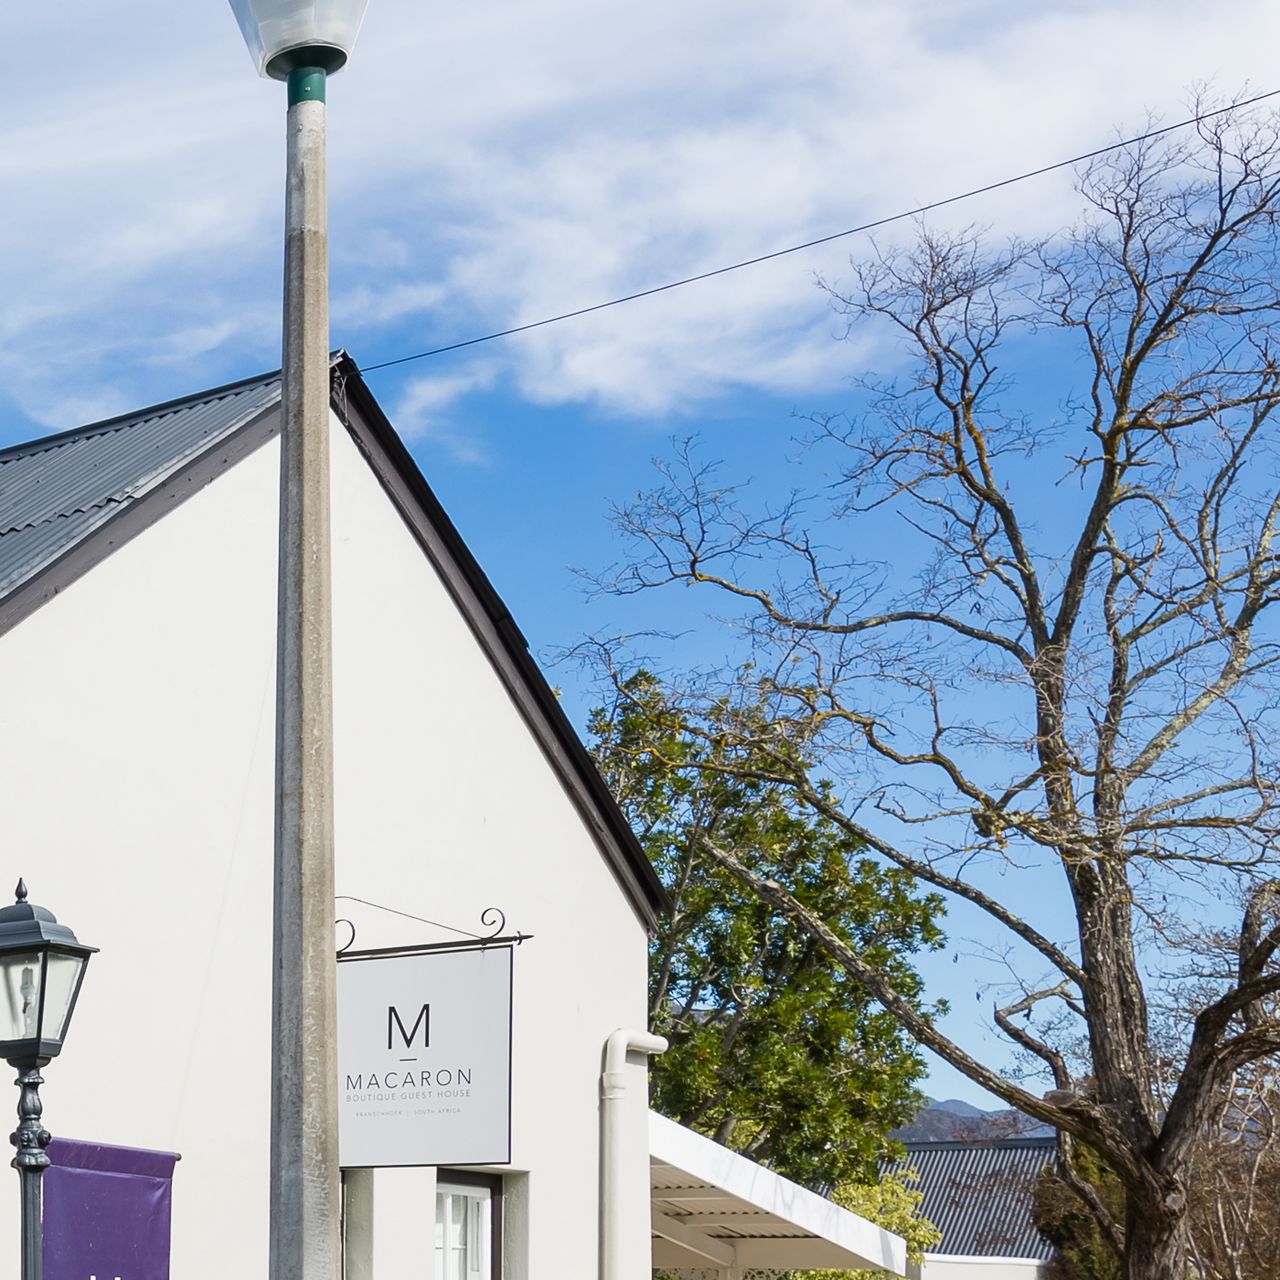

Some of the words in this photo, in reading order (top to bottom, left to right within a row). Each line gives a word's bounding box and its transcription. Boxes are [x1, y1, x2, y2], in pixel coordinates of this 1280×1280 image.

[387, 1003, 430, 1050] M
[346, 1068, 472, 1091] MACARON
[346, 1092, 396, 1102] BOUTIQUE
[400, 1090, 433, 1100] GUEST
[437, 1089, 471, 1098] HOUSE
